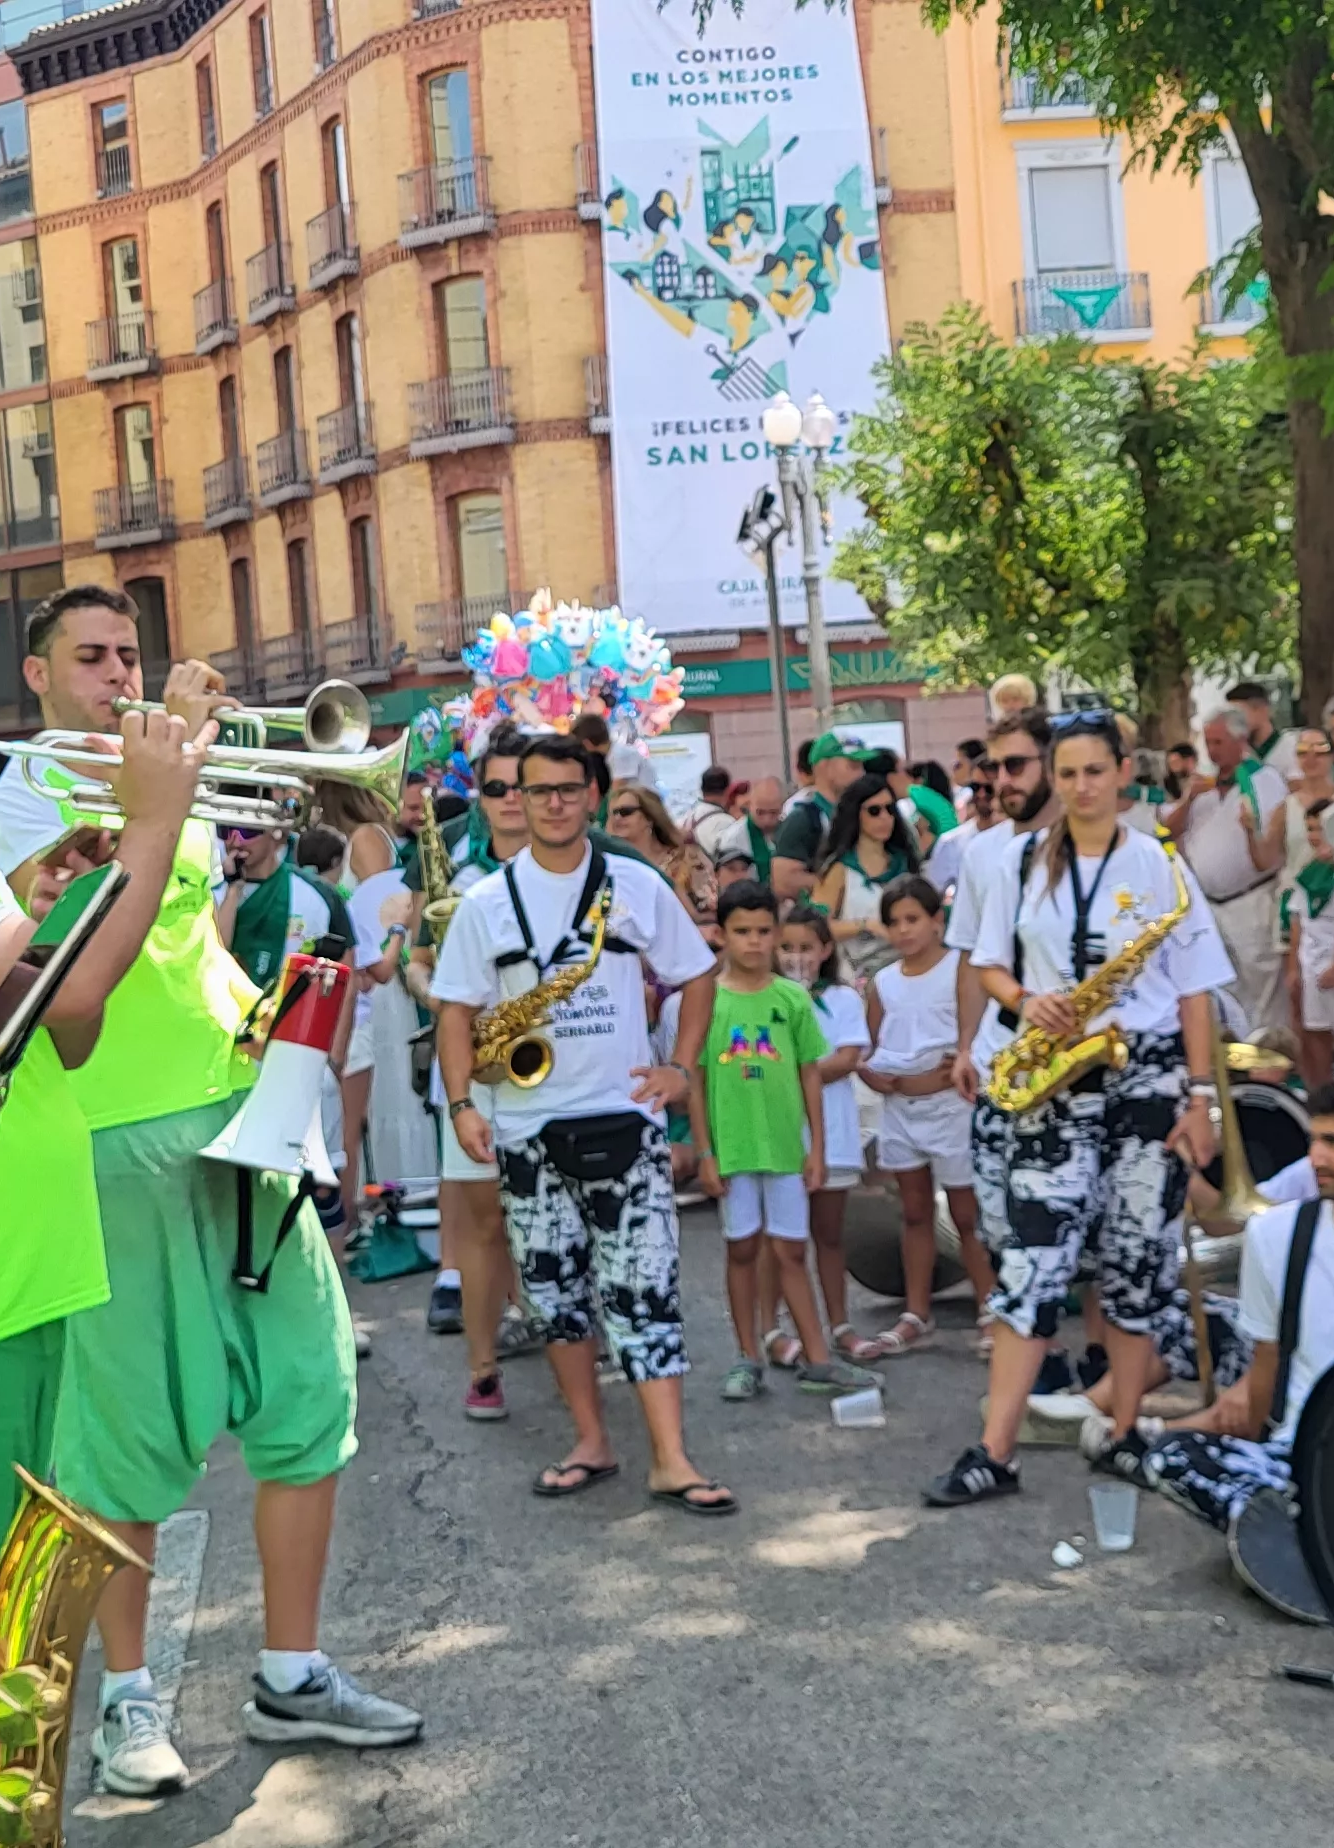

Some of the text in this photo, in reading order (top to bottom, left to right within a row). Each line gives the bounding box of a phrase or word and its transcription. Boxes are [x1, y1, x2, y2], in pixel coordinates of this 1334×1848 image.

[676, 46, 776, 64] CONTIGO
[631, 64, 819, 87] EN LOS MEJORES
[668, 88, 793, 107] MOMENTOS
[647, 444, 708, 466] SAN
[718, 579, 760, 595] CAJA
